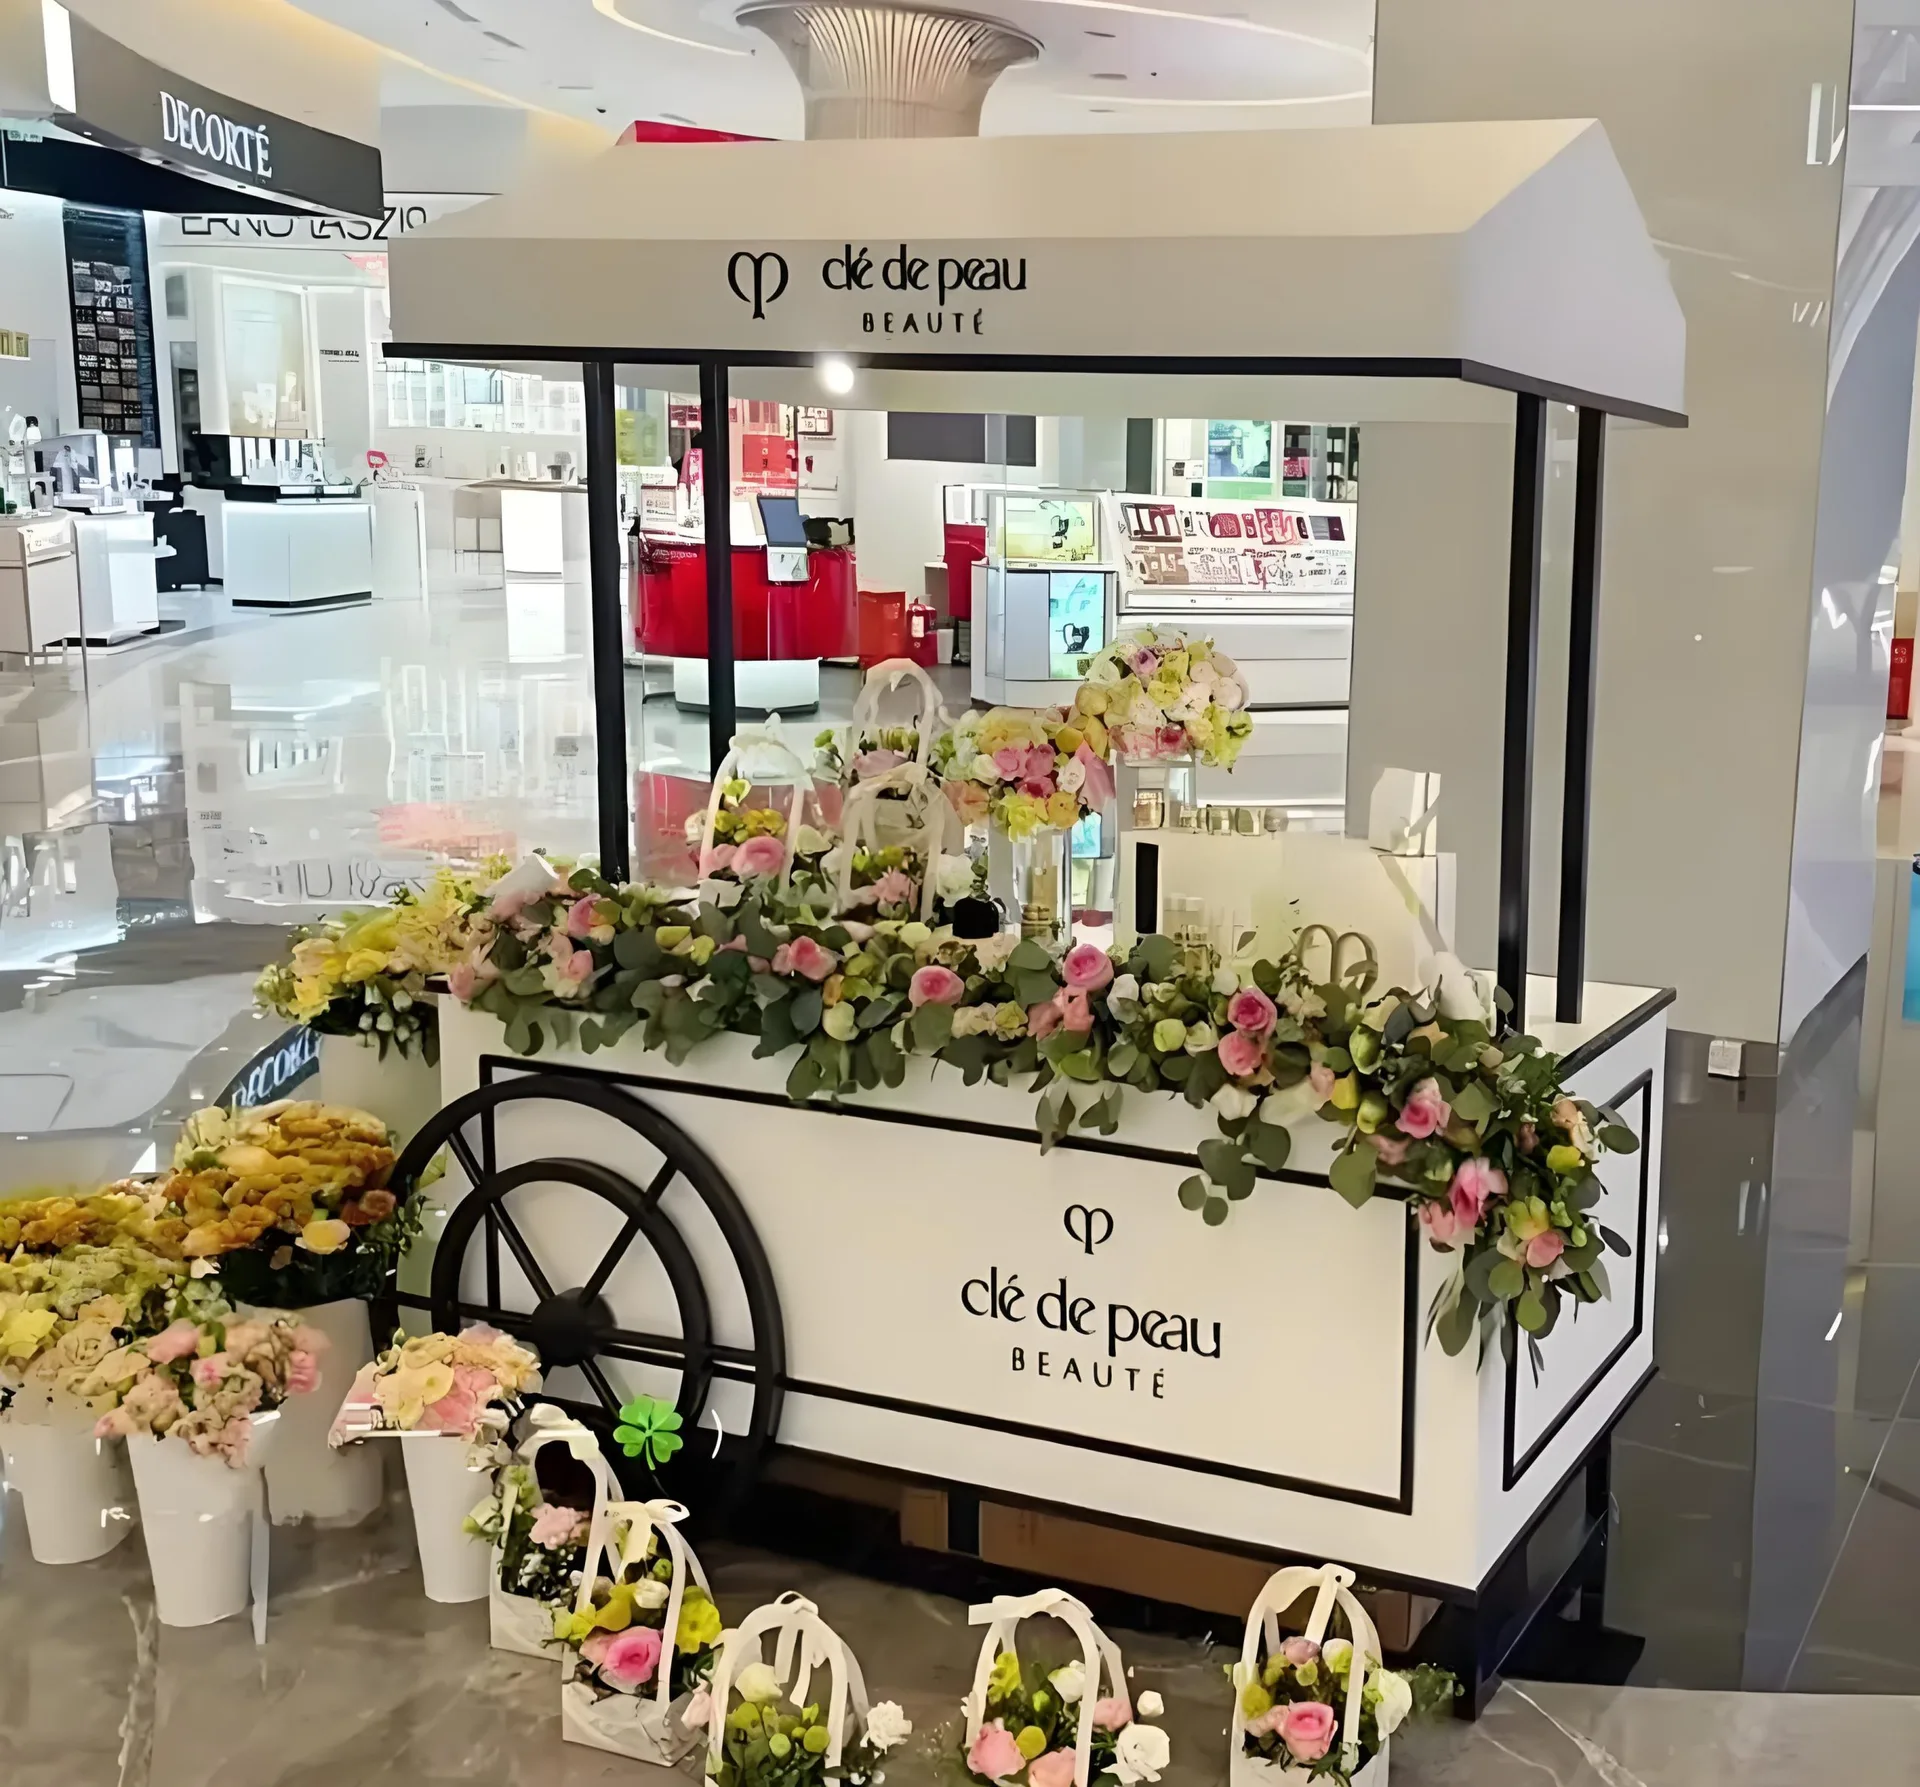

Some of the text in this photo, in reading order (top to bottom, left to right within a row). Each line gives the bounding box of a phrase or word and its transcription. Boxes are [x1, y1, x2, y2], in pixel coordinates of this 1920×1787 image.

[160, 90, 272, 178] DECORTÉ
[822, 243, 1027, 306] clé de peau
[862, 307, 984, 335] BEAUTÉ
[961, 1266, 1221, 1359] clé de peau
[1012, 1346, 1165, 1399] BEAUTÉ
